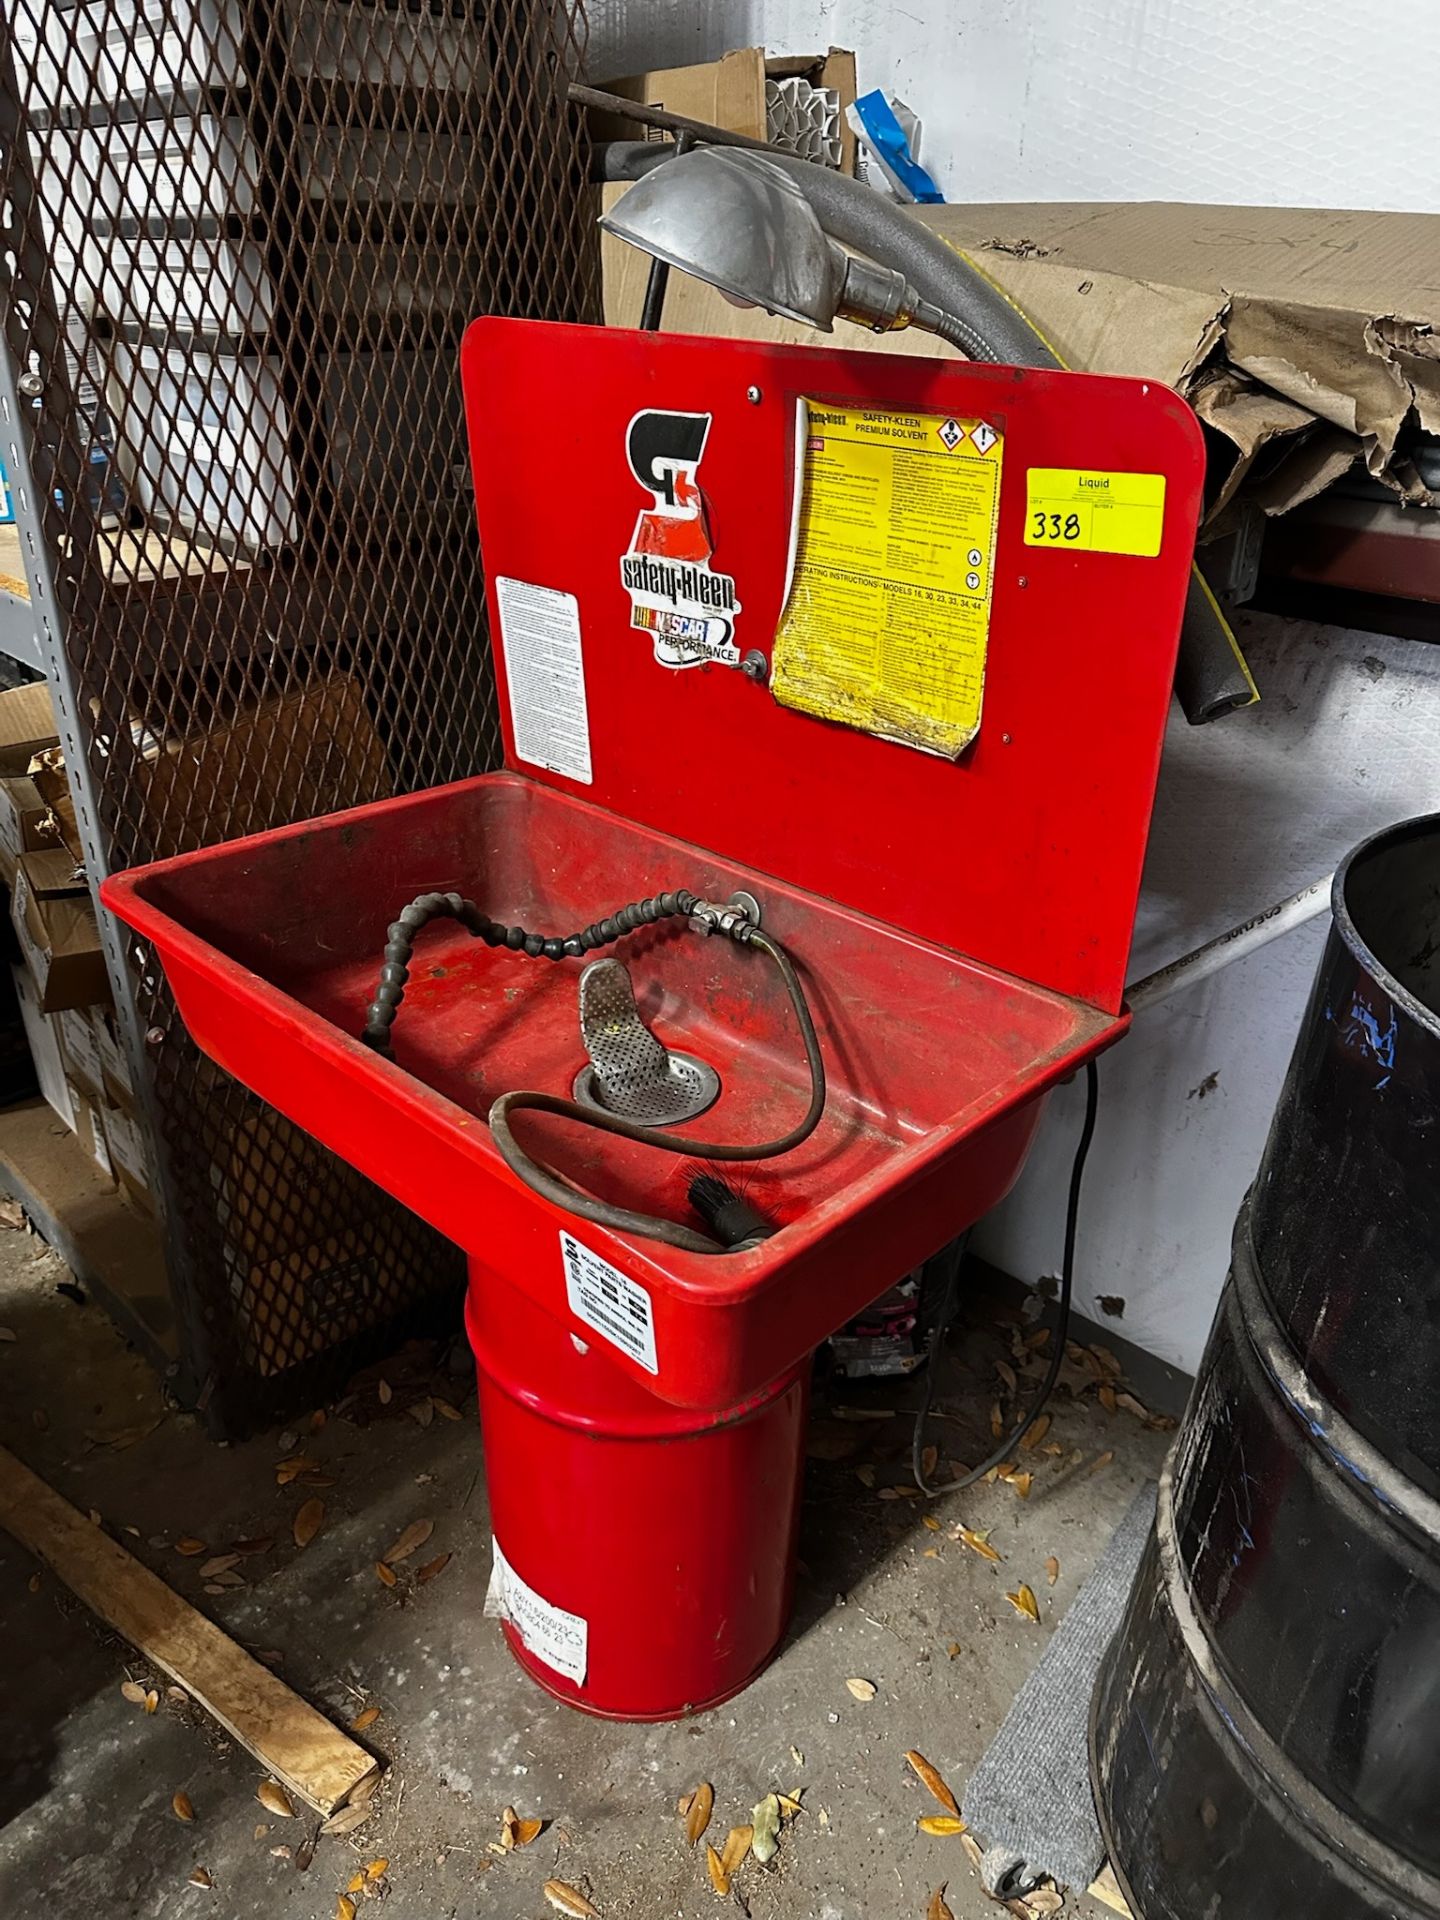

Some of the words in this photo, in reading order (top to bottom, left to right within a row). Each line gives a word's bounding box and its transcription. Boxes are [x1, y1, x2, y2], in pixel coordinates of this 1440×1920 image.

[863, 413, 921, 428] SAFETY-KLEEN
[855, 423, 890, 436] PREMIUM
[891, 428, 928, 441] SOLVENT
[1079, 476, 1110, 489] Liquid
[1032, 512, 1081, 540] 338
[883, 582, 912, 597] MODELS
